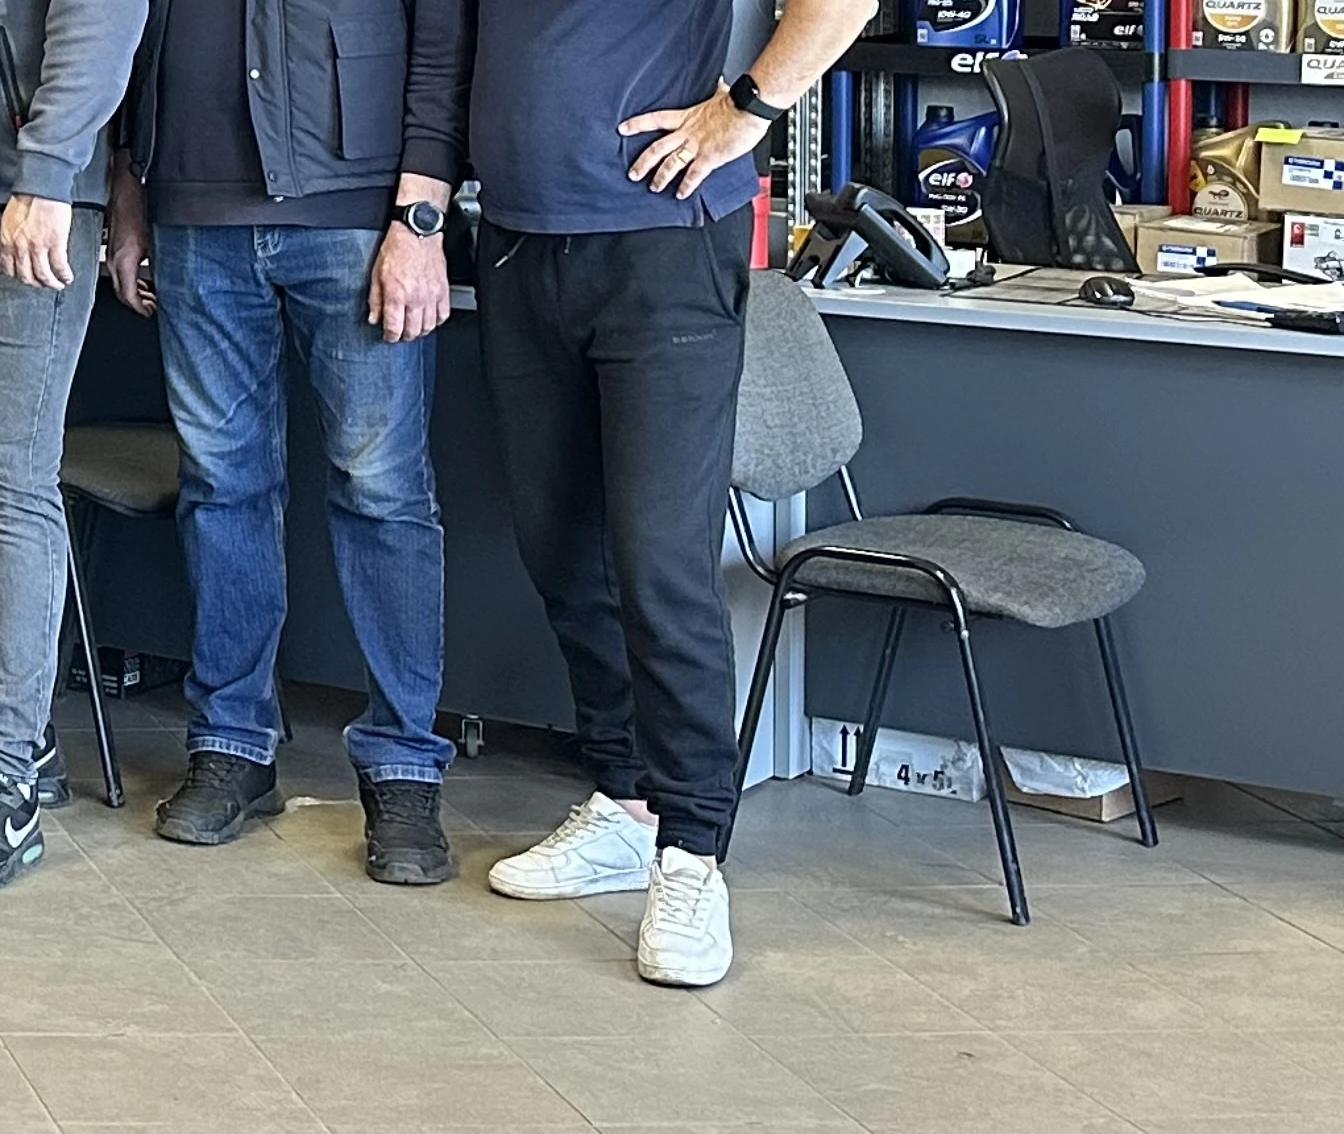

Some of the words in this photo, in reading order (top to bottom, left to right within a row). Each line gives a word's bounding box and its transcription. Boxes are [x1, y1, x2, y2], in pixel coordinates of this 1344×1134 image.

[1205, 0, 1262, 10] QUARTZ
[1113, 25, 1137, 36] elf
[928, 172, 957, 187] elf
[1193, 206, 1244, 219] QUARTZ
[897, 764, 911, 786] 4
